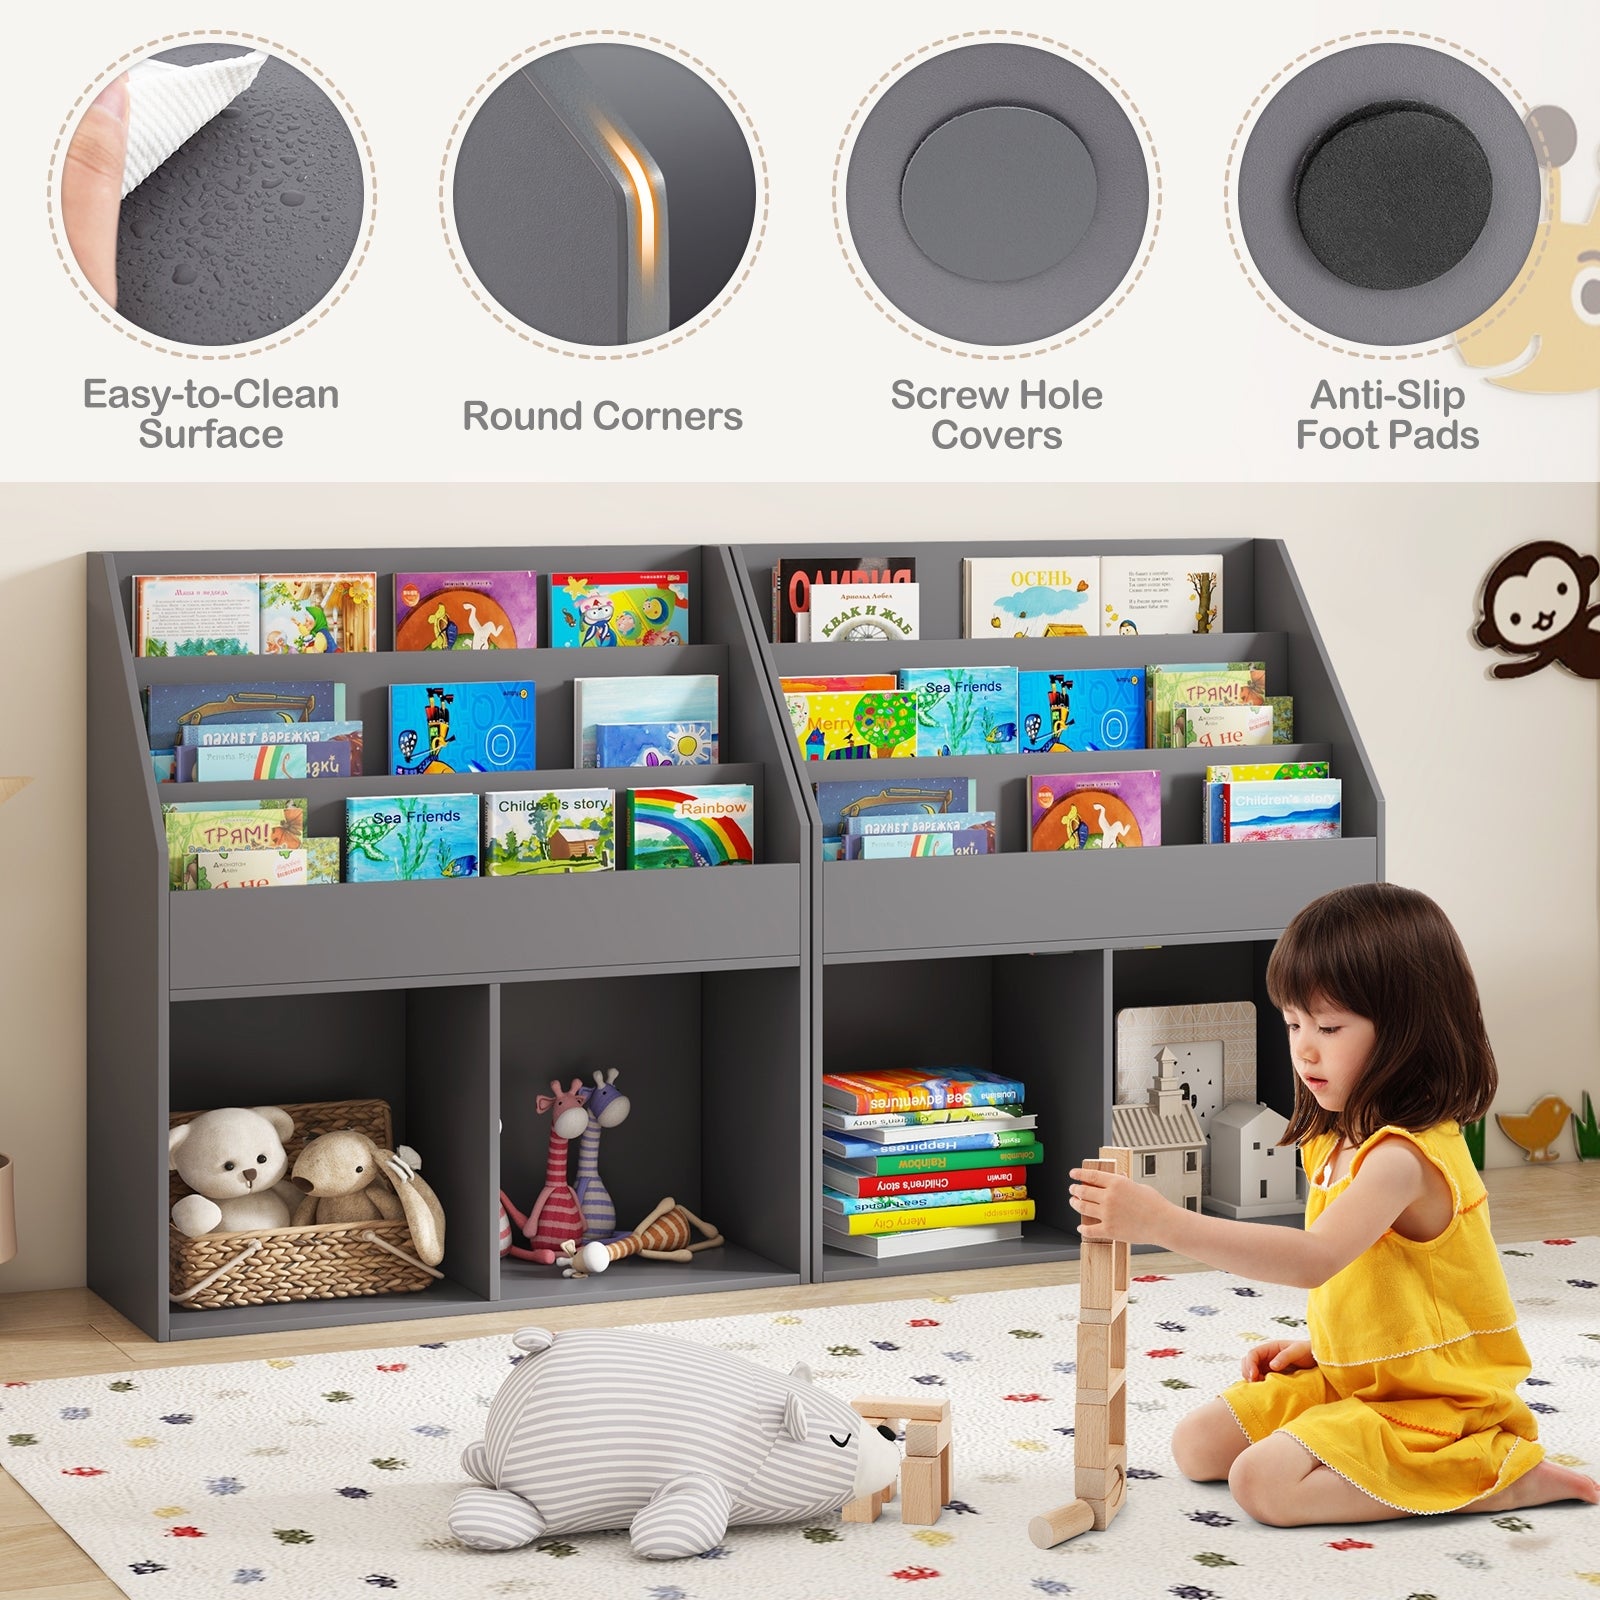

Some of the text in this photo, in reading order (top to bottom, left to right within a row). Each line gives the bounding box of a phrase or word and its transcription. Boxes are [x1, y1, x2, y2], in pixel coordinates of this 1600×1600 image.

[1011, 570, 1073, 587] ОСЕНЬ
[821, 605, 913, 638] КВАК И ЖАБ
[926, 680, 1002, 694] Sea Friends
[1186, 683, 1239, 701] ТРЯМ!
[807, 717, 855, 733] Merry
[1220, 730, 1243, 745] не
[499, 799, 608, 812] Children's story
[1235, 793, 1336, 807] Children's story
[681, 803, 747, 815] Rainbow
[373, 810, 461, 824] Sea Friends
[204, 824, 269, 844] ТРЯМ!
[871, 1091, 1017, 1109] Louisiana Sea adventures
[853, 1119, 878, 1127] story
[880, 1142, 957, 1153] Happiness
[899, 1157, 947, 1169] Rainbow
[877, 1173, 1013, 1191] Darwin Children's story
[873, 1208, 1029, 1229] Mississippi Merry City
